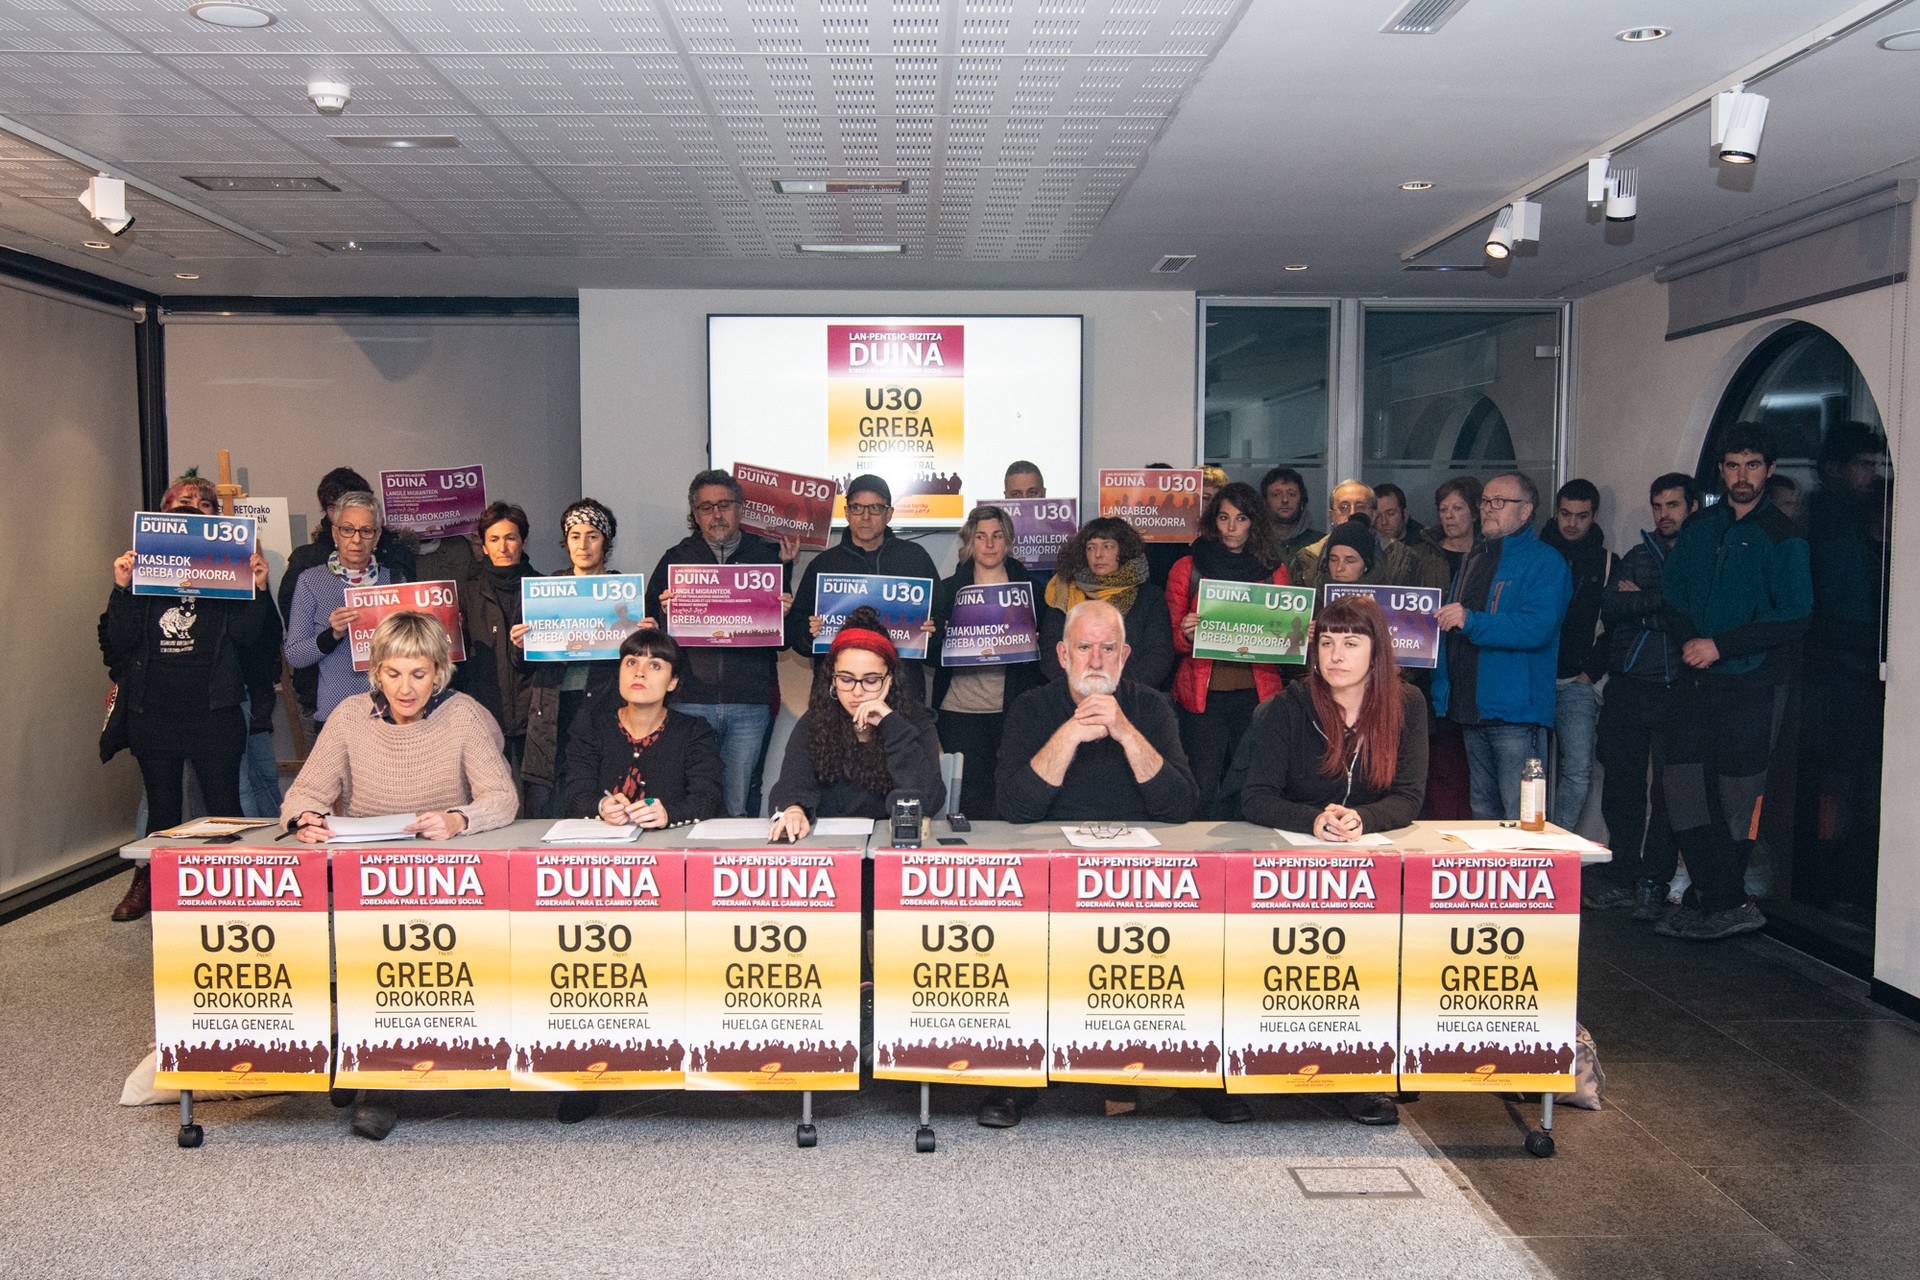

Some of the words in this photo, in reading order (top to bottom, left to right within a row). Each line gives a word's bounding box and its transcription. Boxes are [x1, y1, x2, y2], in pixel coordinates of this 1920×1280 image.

[849, 333, 942, 341] LAN-PENTSIO-BIZITZA
[850, 342, 944, 367] DUINA
[866, 388, 922, 411] U30
[859, 417, 934, 437] GREBA
[858, 440, 934, 452] OROKORRA
[387, 478, 427, 488] DUINA
[440, 472, 477, 489] U30
[738, 470, 778, 486] DUINA
[1105, 477, 1145, 486] DUINA
[1159, 476, 1196, 491] U30
[792, 480, 830, 499] U30
[388, 514, 414, 522] GREBA
[416, 510, 460, 521] OROKORRA
[1035, 505, 1071, 520] U30
[1103, 506, 1158, 515] LANGABEOK
[141, 521, 188, 534] DUINA
[763, 515, 815, 530] OROKORRA
[1135, 517, 1186, 527] OROKORRA
[204, 523, 248, 541] U30
[1018, 534, 1068, 544] LANGILEOK
[138, 554, 191, 566] IKASLEOK
[138, 567, 174, 578] GREBA
[176, 569, 236, 581] OROKORRA
[675, 574, 719, 584] DUINA
[735, 572, 775, 589] U30
[530, 586, 577, 597] DUINA
[593, 582, 636, 600] U30
[823, 583, 868, 594] DUINA
[883, 584, 924, 602] U30
[1206, 589, 1250, 602] DUINA
[353, 594, 400, 607] DUINA
[415, 588, 453, 607] U30
[998, 590, 1028, 607] U30
[1265, 592, 1307, 612] U30
[1391, 594, 1433, 612] U30
[529, 618, 604, 631] MERKATARIOK
[672, 615, 701, 624] GREBA
[703, 615, 753, 624] OROKORRA
[1201, 620, 1264, 634] OSTALARIOK
[530, 632, 564, 643] GREBA
[567, 630, 627, 641] OROKORRA
[946, 638, 975, 648] GREBA
[977, 634, 1031, 647] OROKORRA
[1200, 632, 1233, 644] GREBA
[1235, 634, 1291, 647] OROKORRA
[178, 856, 299, 864] LAN-PENTSIO-BIZITZA
[360, 855, 480, 863] LAN-PENTSIO-BIZITZA
[537, 856, 656, 864] LAN-PENTSIO-BIZITZA
[714, 856, 833, 865] LAN-PENTSIO-BIZITZA
[902, 856, 1021, 864] LAN-PENTSIO-BIZITZA
[1078, 857, 1197, 866] LAN-PENTSIO-BIZITZA
[1254, 858, 1373, 867] LAN-PENTSIO-BIZITZA
[1432, 858, 1553, 867] LAN-PENTSIO-BIZITZA
[179, 868, 302, 897] DUINA
[361, 866, 483, 896] DUINA
[537, 868, 659, 897] DUINA
[714, 868, 835, 897] DUINA
[902, 867, 1023, 897] DUINA
[1078, 869, 1199, 898] DUINA
[1253, 870, 1375, 899] DUINA
[1432, 870, 1554, 899] DUINA
[712, 899, 751, 907] SOBERANÍA
[1252, 901, 1291, 909] SOBERANÍA
[201, 925, 275, 952] U30
[383, 924, 456, 951] U30
[559, 925, 631, 952] U30
[734, 925, 806, 952] U30
[922, 925, 994, 952] U30
[1098, 927, 1170, 954] U30
[1273, 927, 1345, 954] U30
[1451, 927, 1524, 955] U30
[194, 963, 291, 989] GREBA
[377, 962, 473, 988] GREBA
[551, 963, 647, 989] GREBA
[726, 963, 821, 988] GREBA
[914, 963, 1009, 988] GREBA
[1089, 965, 1184, 990] GREBA
[1264, 966, 1359, 991] GREBA
[1442, 966, 1538, 991] GREBA
[194, 992, 292, 1008] OROKORRA
[376, 991, 474, 1006] OROKORRA
[551, 992, 648, 1007] OROKORRA
[725, 992, 822, 1007] OROKORRA
[913, 992, 1009, 1006] OROKORRA
[1088, 994, 1184, 1008] OROKORRA
[1263, 995, 1359, 1010] OROKORRA
[1440, 995, 1538, 1010] OROKORRA
[193, 1019, 238, 1029] HUELGA
[242, 1019, 294, 1030] GENERAL
[375, 1018, 421, 1028] HUELGA
[424, 1017, 477, 1027] GENERAL
[549, 1019, 594, 1029] HUELGA
[598, 1019, 650, 1029] GENERAL
[723, 1019, 767, 1029] HUELGA
[771, 1019, 823, 1030] GENERAL
[911, 1018, 955, 1027] HUELGA
[959, 1018, 1010, 1028] GENERAL
[1085, 1020, 1130, 1030] HUELGA
[1134, 1020, 1185, 1030] GENERAL
[1261, 1022, 1305, 1032] HUELGA
[1309, 1022, 1361, 1032] GENERAL
[1438, 1021, 1483, 1032] HUELGA
[1487, 1022, 1539, 1032] GENERAL
